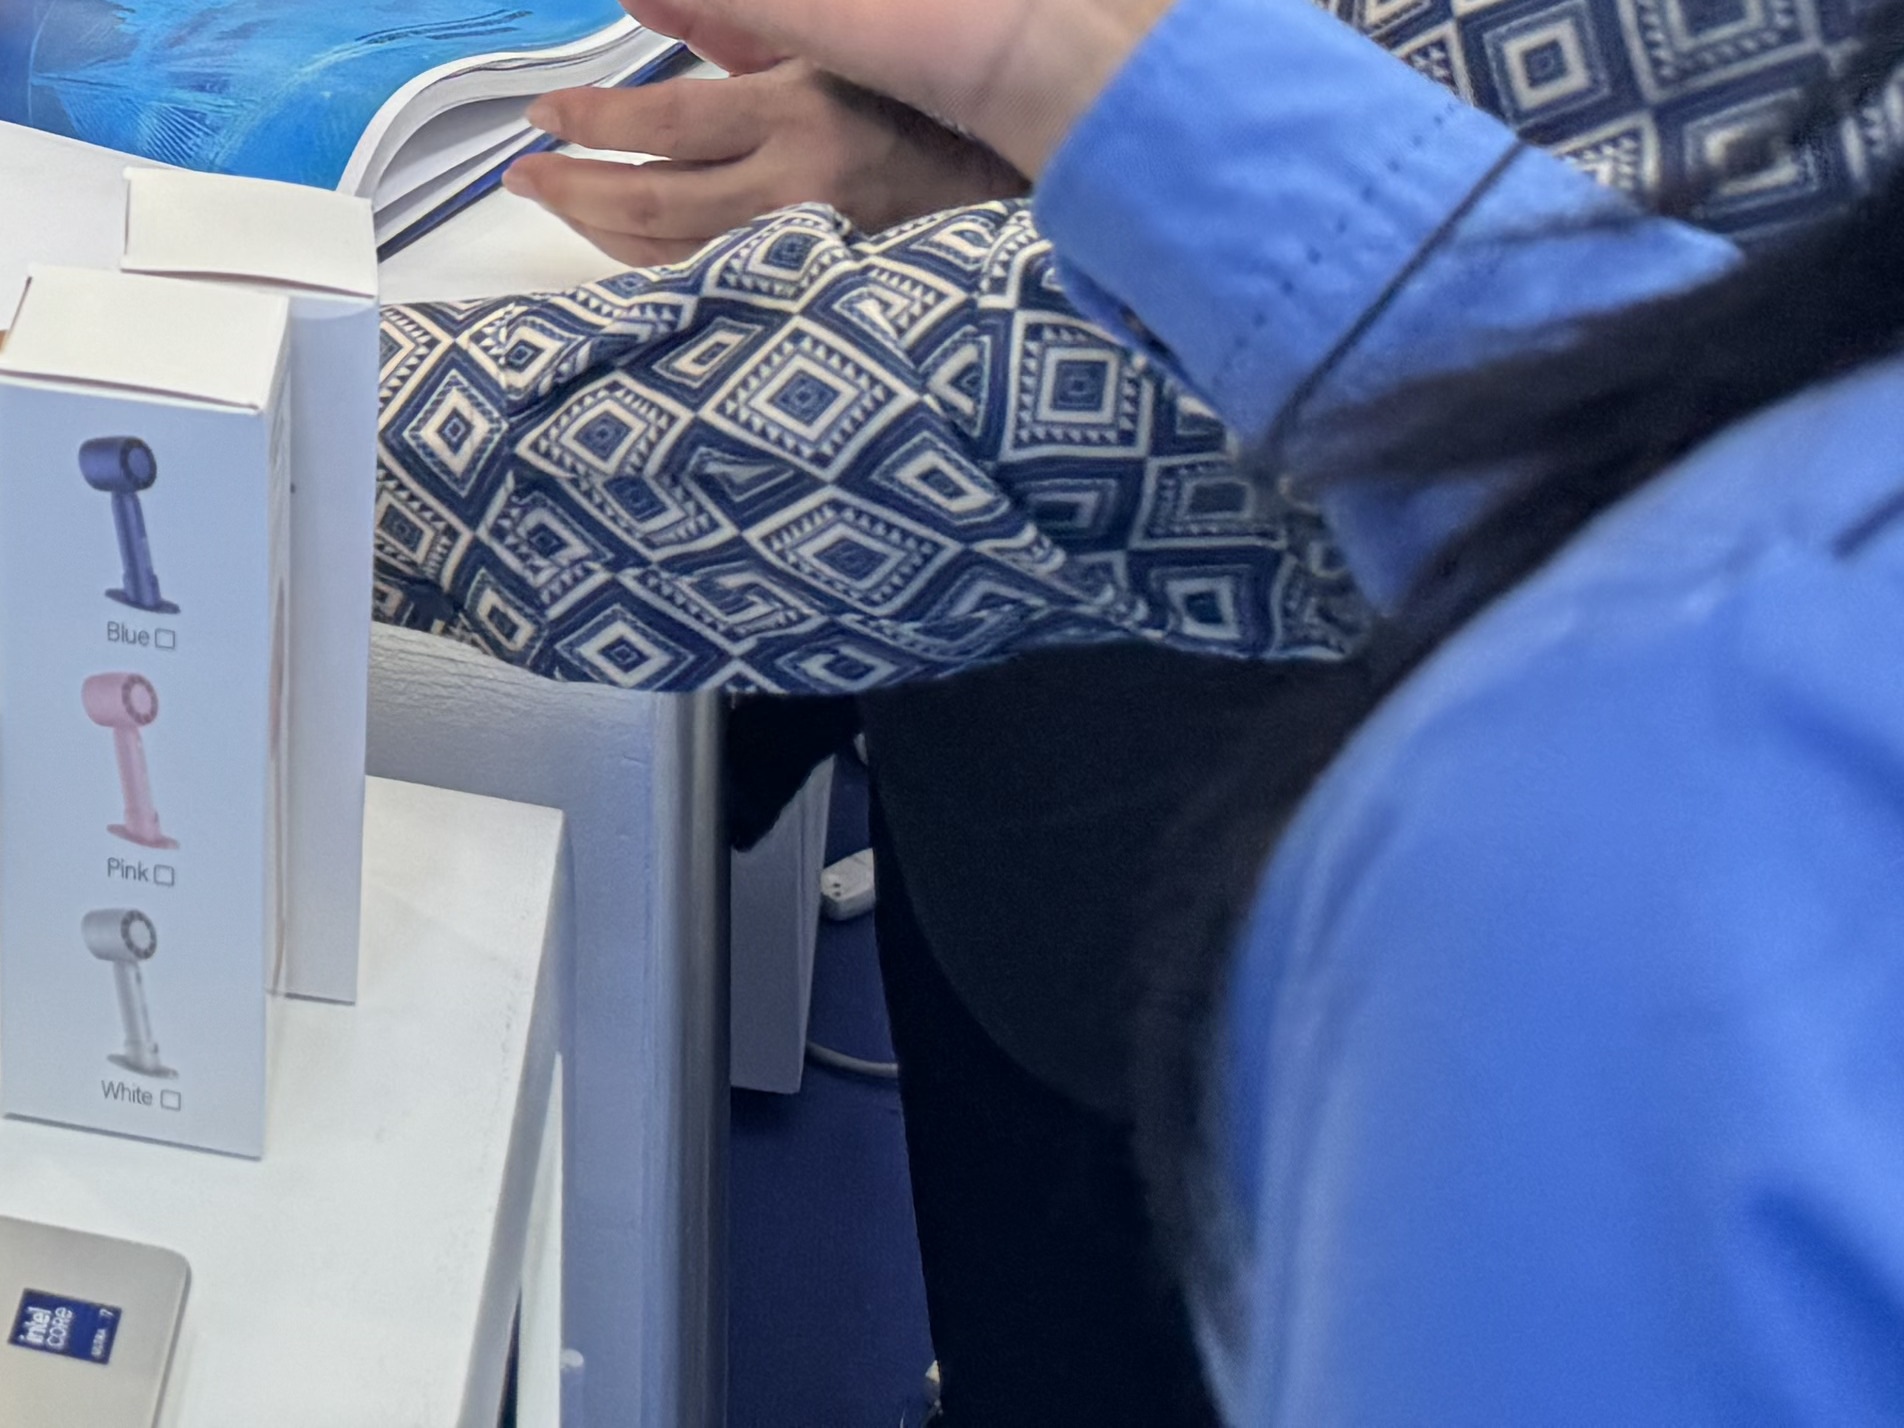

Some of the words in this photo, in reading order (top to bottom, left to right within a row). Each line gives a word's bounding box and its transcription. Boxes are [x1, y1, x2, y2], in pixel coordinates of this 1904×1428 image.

[107, 620, 151, 646] Blue
[107, 857, 149, 882] Pink
[101, 1079, 153, 1106] White
[18, 1306, 52, 1344] intel
